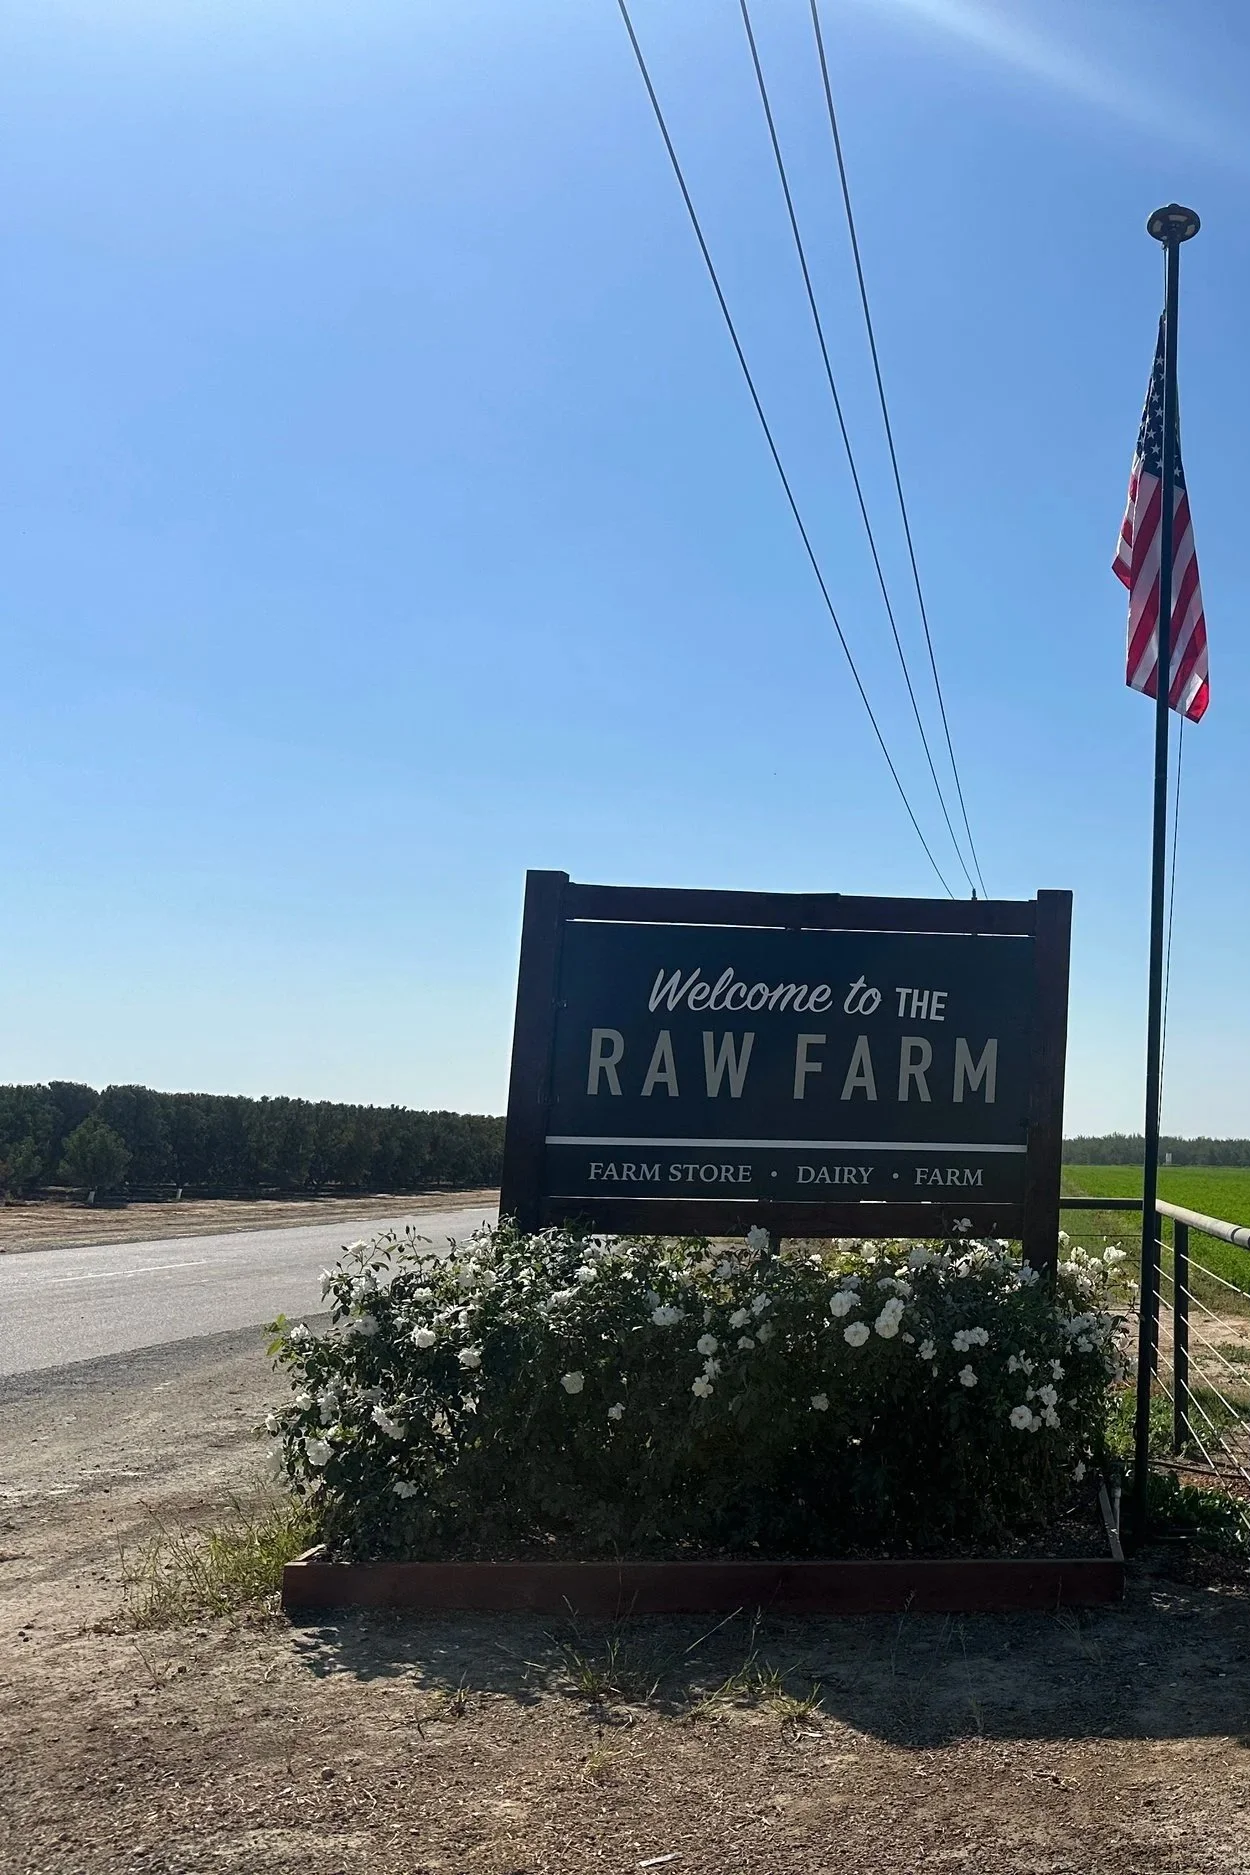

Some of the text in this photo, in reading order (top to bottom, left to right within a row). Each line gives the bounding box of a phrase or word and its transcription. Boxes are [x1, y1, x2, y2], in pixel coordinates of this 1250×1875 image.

[649, 967, 948, 1021] Welcome to THE
[587, 1028, 997, 1103] RAW FARM
[588, 1163, 983, 1185] FARM STORE DAIRY FARM
